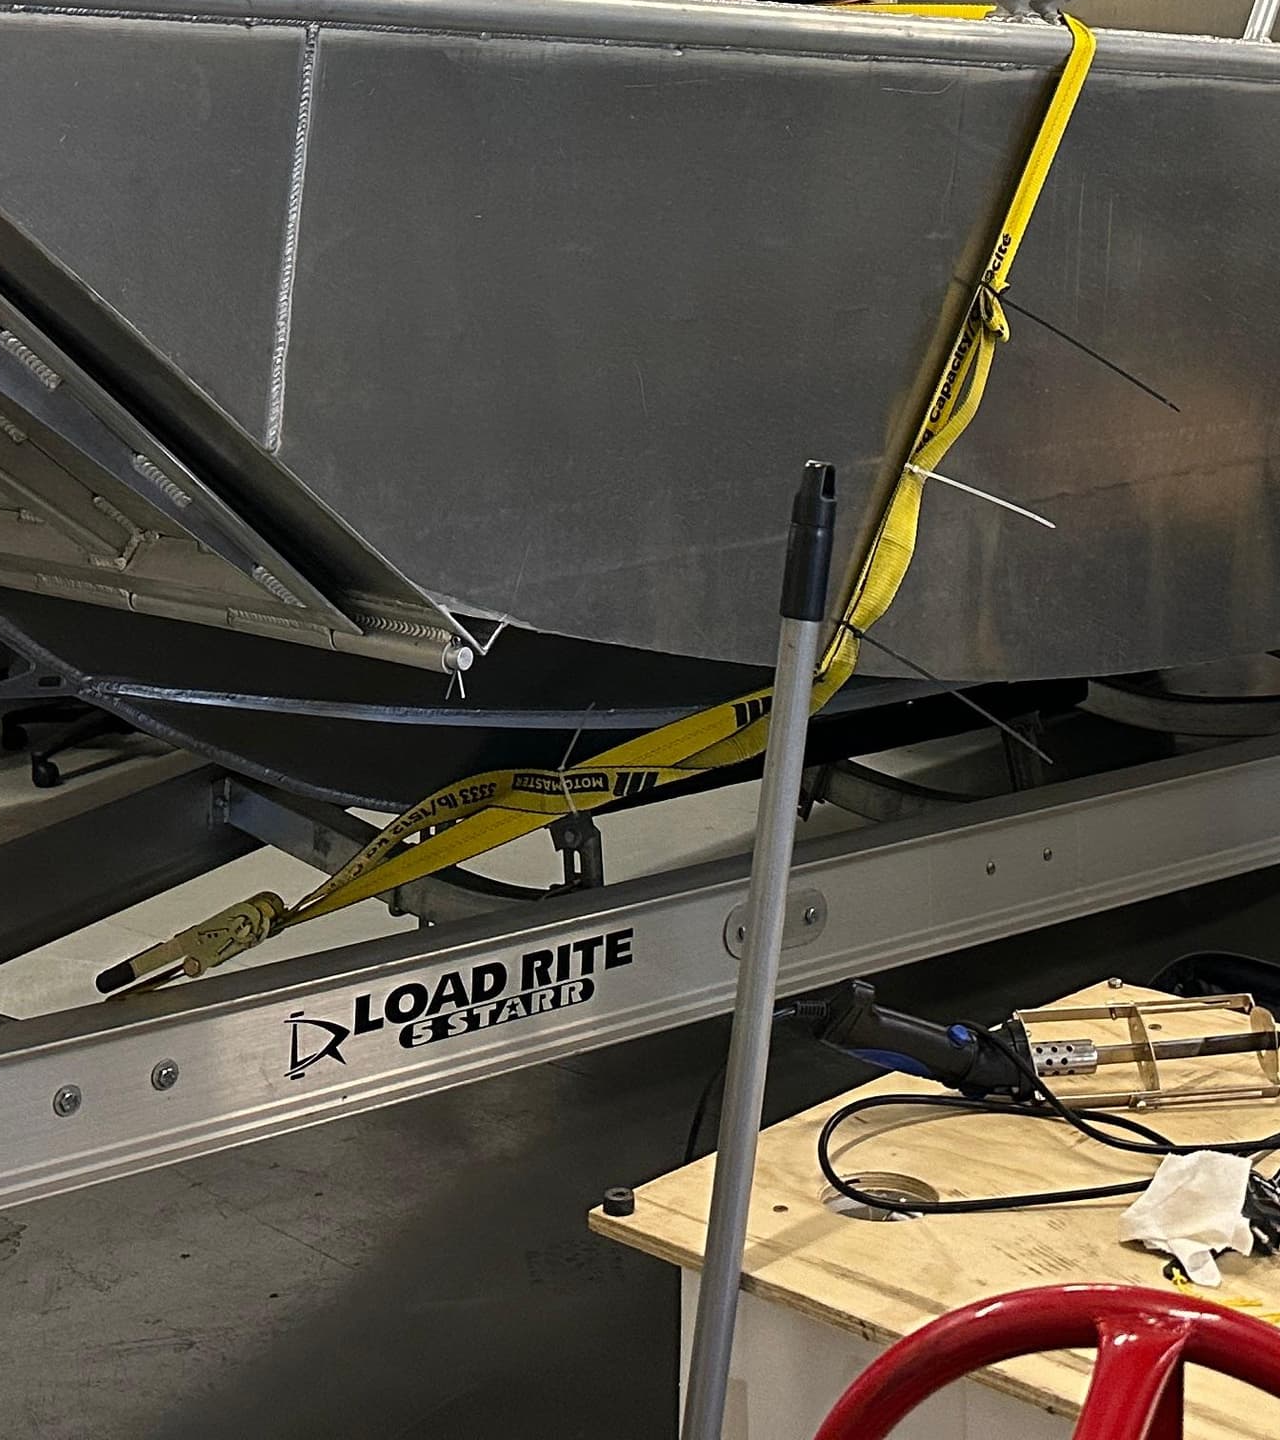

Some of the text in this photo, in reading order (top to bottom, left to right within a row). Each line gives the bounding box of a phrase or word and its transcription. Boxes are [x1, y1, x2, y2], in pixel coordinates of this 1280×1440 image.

[354, 928, 634, 1035] LOAD RITE
[411, 1020, 433, 1046] 5
